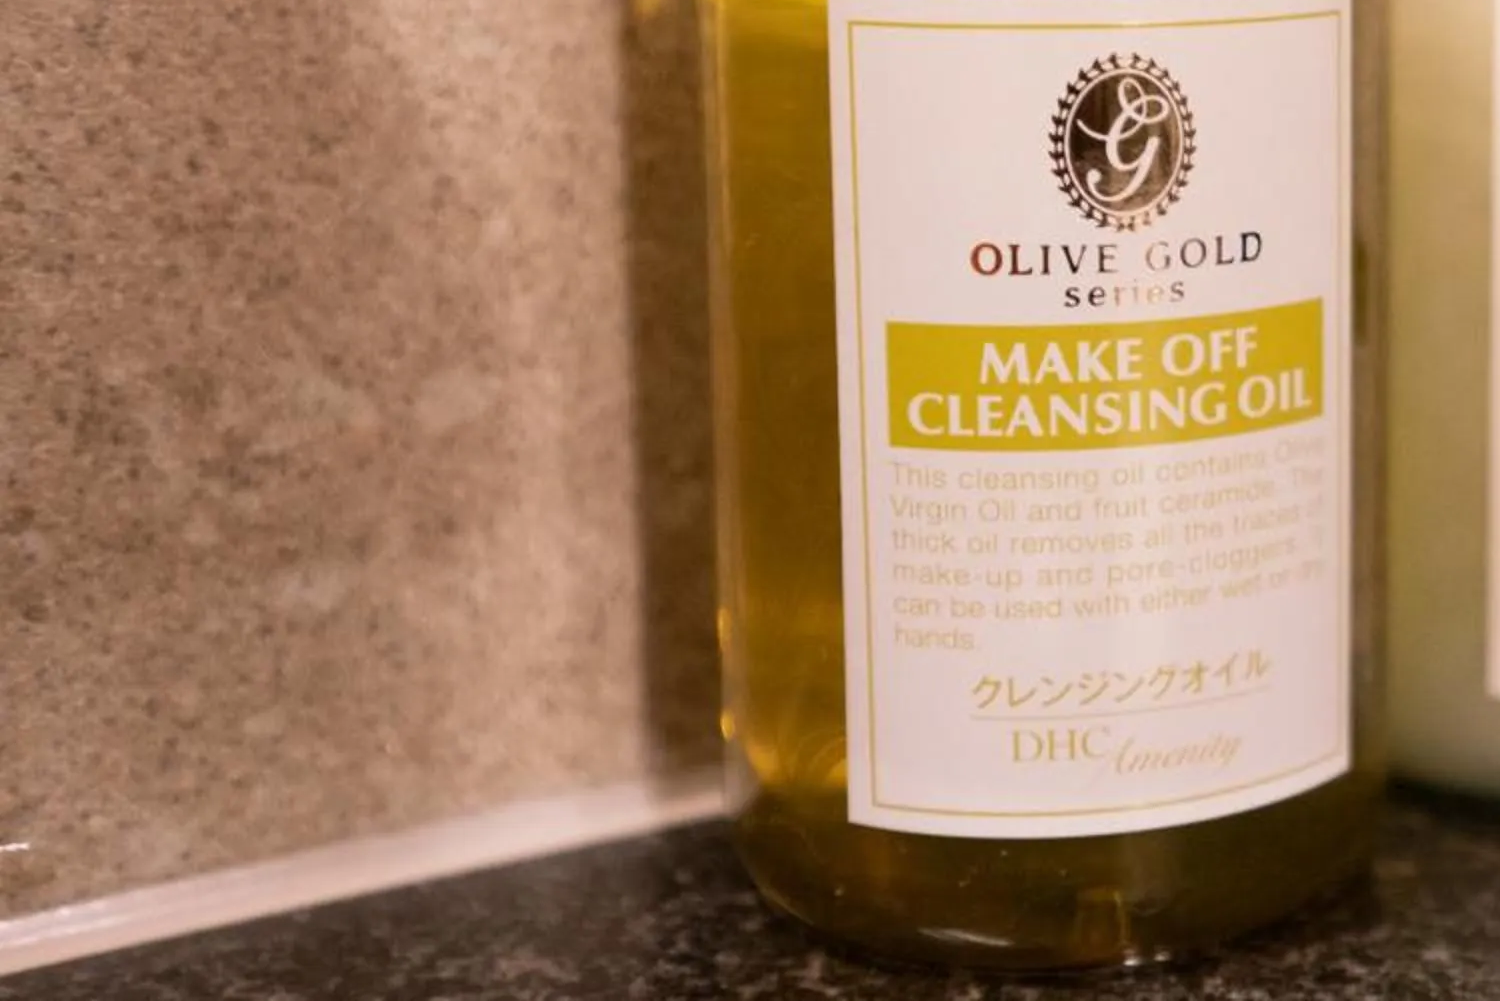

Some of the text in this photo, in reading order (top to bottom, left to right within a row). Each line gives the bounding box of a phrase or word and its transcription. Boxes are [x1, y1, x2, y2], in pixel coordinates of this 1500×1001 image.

[970, 231, 1264, 276] OLIVE GOLD
[1063, 280, 1186, 308] series
[979, 326, 1259, 386] MAKE OFF
[906, 367, 1313, 438] CLEANSING OIL
[891, 462, 948, 491] This
[957, 465, 1100, 493] cleansing
[1111, 459, 1145, 487] oil
[1155, 449, 1268, 484] contains
[889, 496, 967, 526] Virgin
[977, 497, 1016, 522] Oil
[1026, 499, 1082, 522] and
[1092, 496, 1148, 519] fruit
[892, 528, 957, 554] thick
[966, 531, 998, 554] oil
[1010, 530, 1134, 556] removes
[1144, 522, 1174, 549] all
[1184, 518, 1225, 547] the
[892, 562, 1025, 592] make-up
[1036, 564, 1093, 587] and
[892, 596, 940, 616] can
[950, 595, 987, 619] be
[994, 596, 1062, 619] used
[1073, 592, 1132, 615] with
[1011, 727, 1108, 764] DHC
